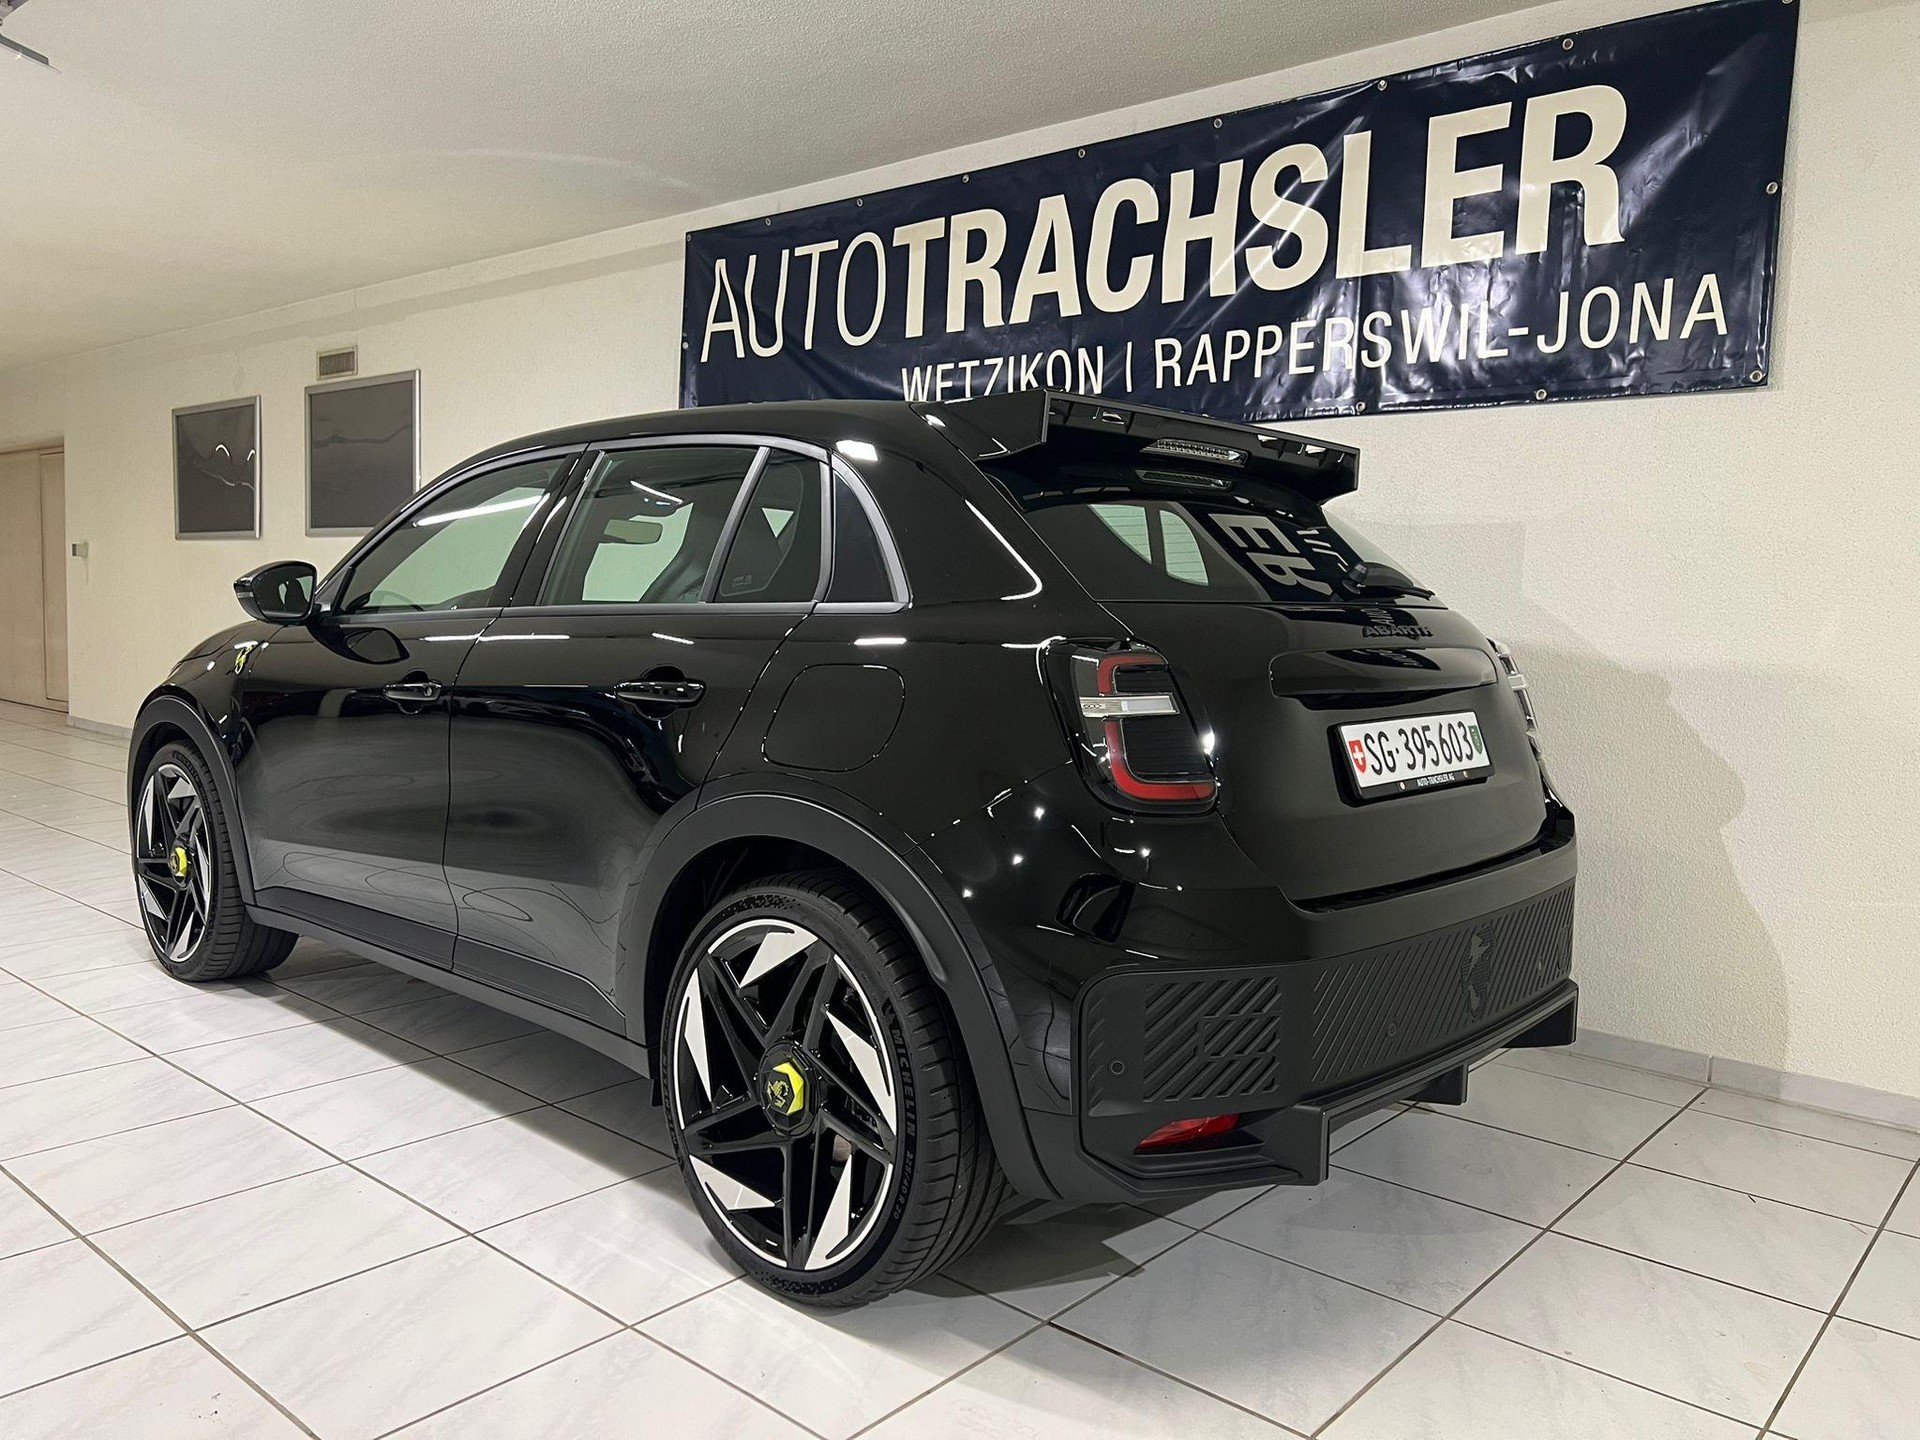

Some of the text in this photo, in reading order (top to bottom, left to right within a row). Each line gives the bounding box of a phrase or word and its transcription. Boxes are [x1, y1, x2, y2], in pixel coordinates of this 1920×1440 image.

[901, 345, 1104, 402] WETZIKON
[1155, 273, 1727, 390] RAPPERSWIL-JONA
[1362, 624, 1433, 638] ABARTH
[891, 1028, 916, 1137] MICHELIN
